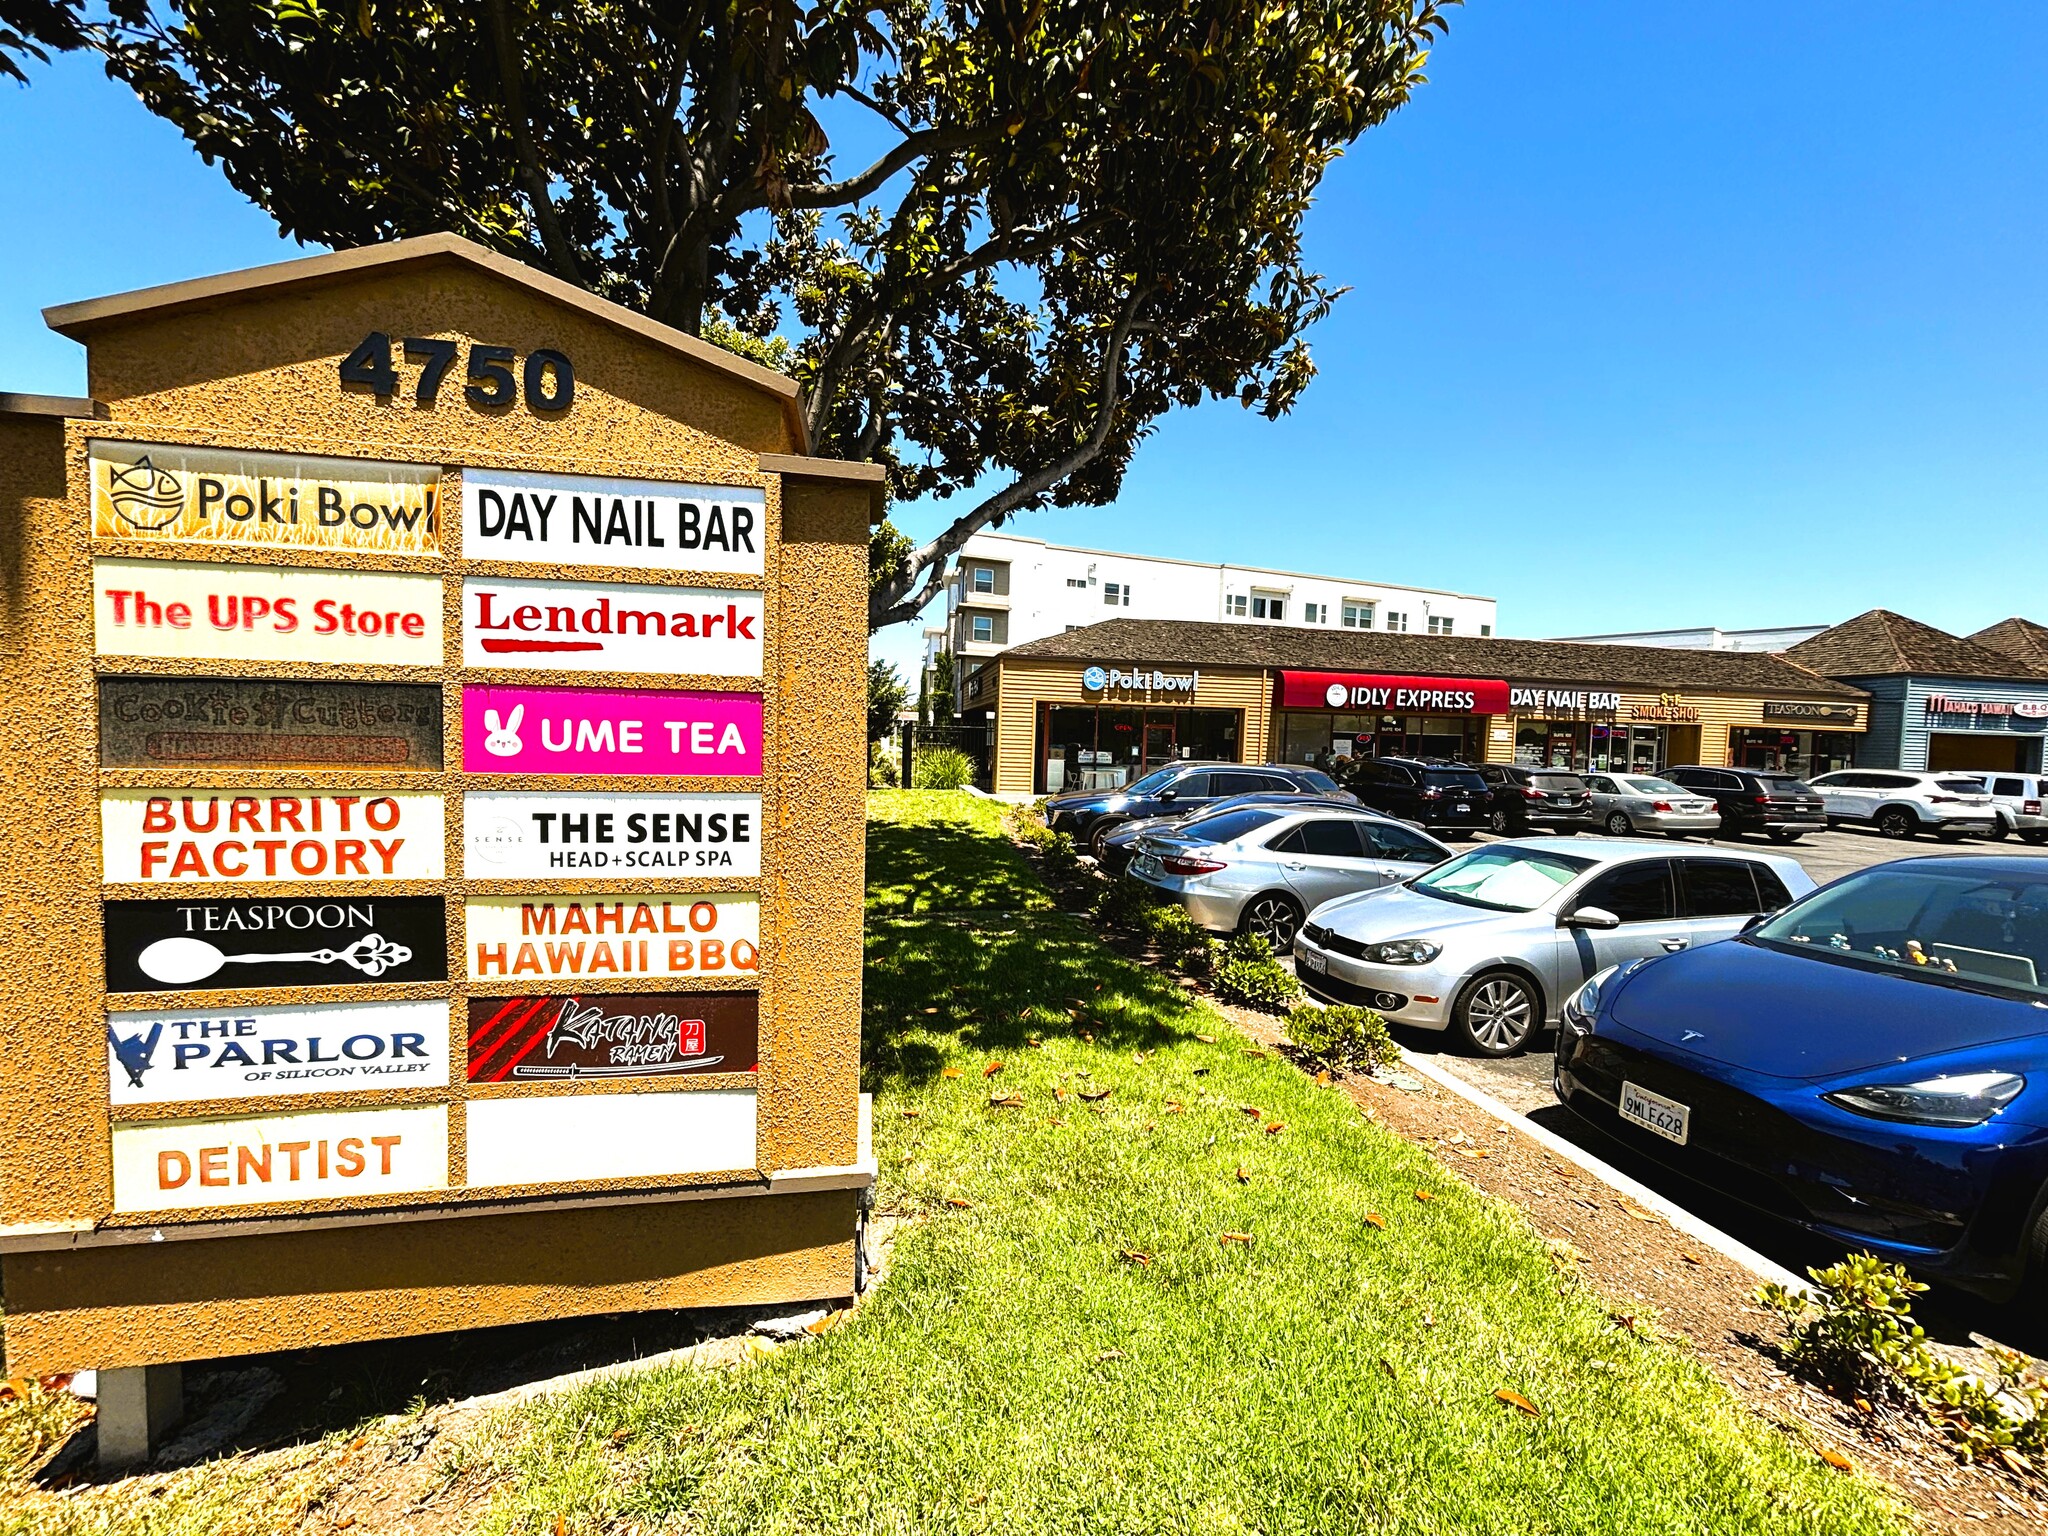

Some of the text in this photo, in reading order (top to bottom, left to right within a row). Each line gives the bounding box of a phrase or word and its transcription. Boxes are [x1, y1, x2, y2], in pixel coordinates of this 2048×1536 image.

[340, 330, 575, 410] 4750
[198, 478, 433, 533] Poki Bowl
[478, 489, 755, 553] DAY NAIL BAR
[105, 589, 426, 637] The UPS Store
[474, 593, 756, 640] Lendmark
[1109, 667, 1199, 692] Poki Bowl
[1350, 687, 1475, 709] IDLY EXPRESS
[1510, 688, 1621, 709] DAY NAIL BAR
[1632, 705, 1700, 719] SMOKE SHOP
[1767, 703, 1820, 716] TEASPOON
[1980, 703, 2013, 715] HAWAII
[541, 718, 746, 755] UME TEA
[142, 796, 401, 834] BURRITO
[532, 813, 751, 844] THE SENSE
[141, 839, 405, 878] FACTORY
[549, 850, 733, 868] HEAD+SCALP SPA
[176, 904, 374, 932] TEASPOON
[521, 900, 718, 936] MAHALO
[477, 939, 759, 976] HAWAII BBQ
[171, 1019, 258, 1040] THE
[547, 998, 680, 1059] KATANA
[685, 1022, 700, 1052] 刀屋
[172, 1032, 430, 1071] PARLOR
[609, 1042, 677, 1066] RAMEN
[244, 1063, 430, 1082] OF SILICON VALLEY
[1624, 1097, 1683, 1136] 9MLF628
[158, 1135, 402, 1190] DENTIST
